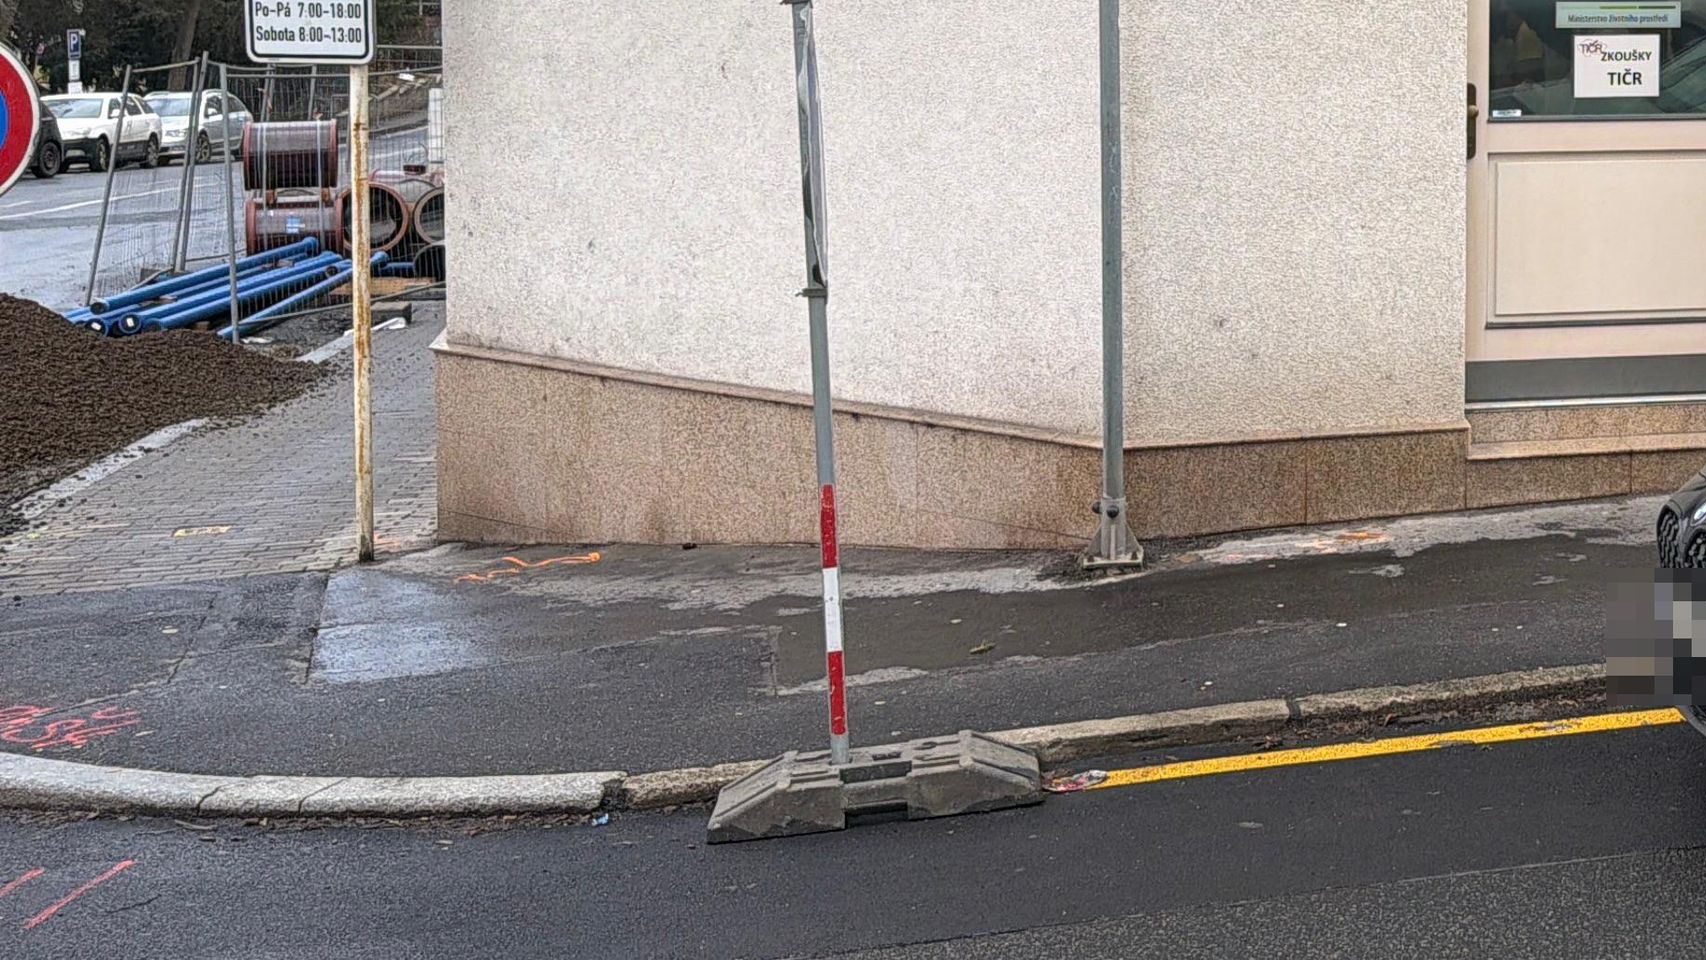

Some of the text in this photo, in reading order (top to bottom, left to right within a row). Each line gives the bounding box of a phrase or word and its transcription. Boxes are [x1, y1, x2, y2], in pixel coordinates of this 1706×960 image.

[255, 1, 362, 19] Po-Pá 7:00-18:00
[1568, 14, 1608, 23] Ministerstvo
[70, 33, 78, 51] P
[256, 25, 362, 44] Sobota 8:00-13:00
[1600, 48, 1652, 62] ZKOUŠKY
[1606, 68, 1643, 86] TIČR
